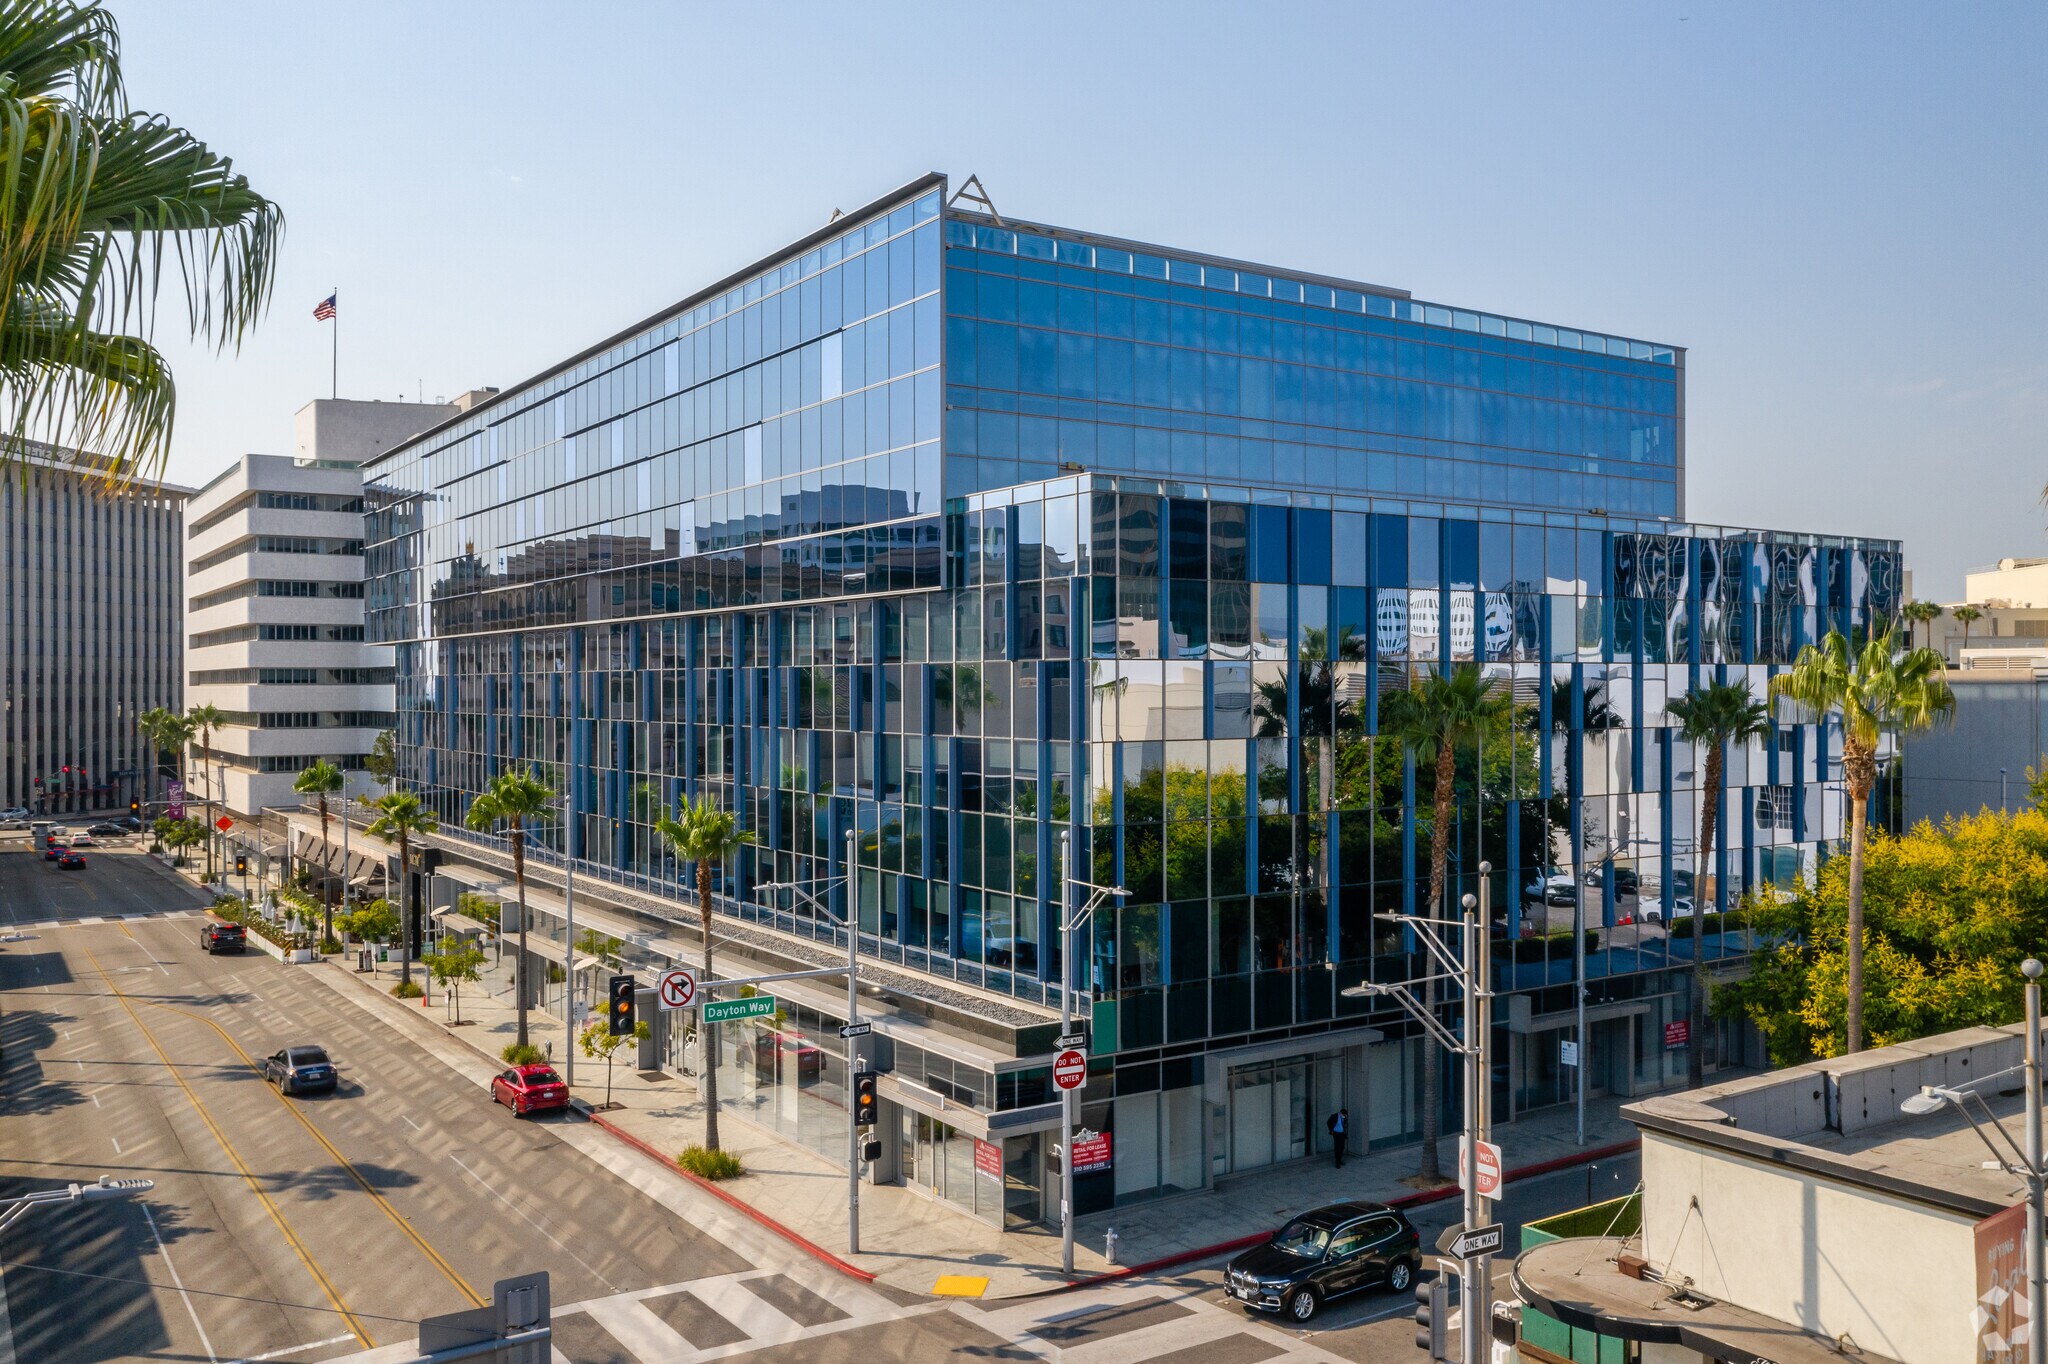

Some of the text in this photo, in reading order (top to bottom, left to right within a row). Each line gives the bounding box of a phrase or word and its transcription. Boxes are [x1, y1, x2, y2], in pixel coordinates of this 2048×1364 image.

[708, 1002, 770, 1018] Dayton Way
[1058, 1056, 1081, 1066] DO NOT
[1060, 1074, 1080, 1083] ENTER
[1480, 1152, 1494, 1163] NOT
[1478, 1175, 1491, 1186] TER
[1464, 1233, 1497, 1251] ONE WAY
[1988, 1238, 2015, 1264] BUYING
